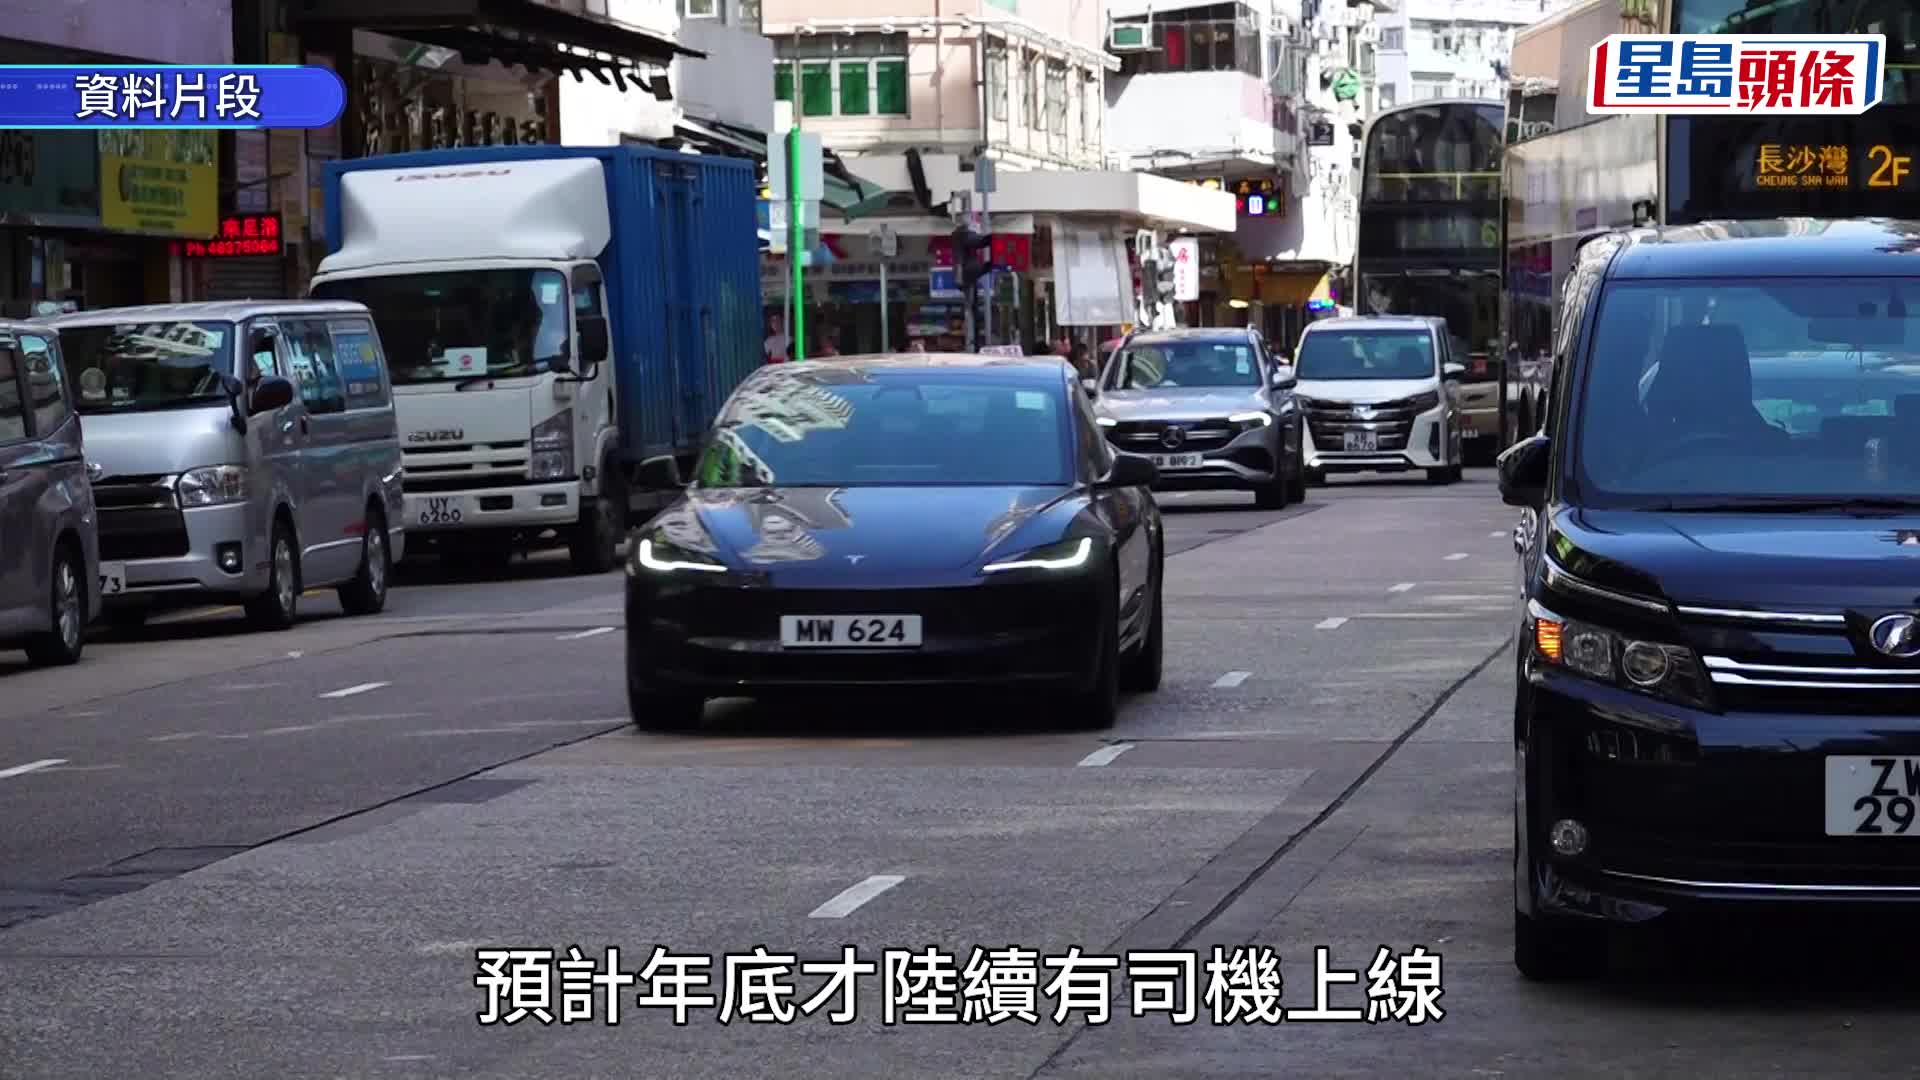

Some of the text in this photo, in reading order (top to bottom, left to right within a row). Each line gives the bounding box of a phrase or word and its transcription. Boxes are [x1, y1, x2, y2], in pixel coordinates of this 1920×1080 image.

[1756, 144, 1849, 175] 長沙灣
[1868, 144, 1912, 187] 2F
[420, 509, 462, 525] 6260
[796, 619, 906, 643] MW 624
[1853, 796, 1916, 834] 29
